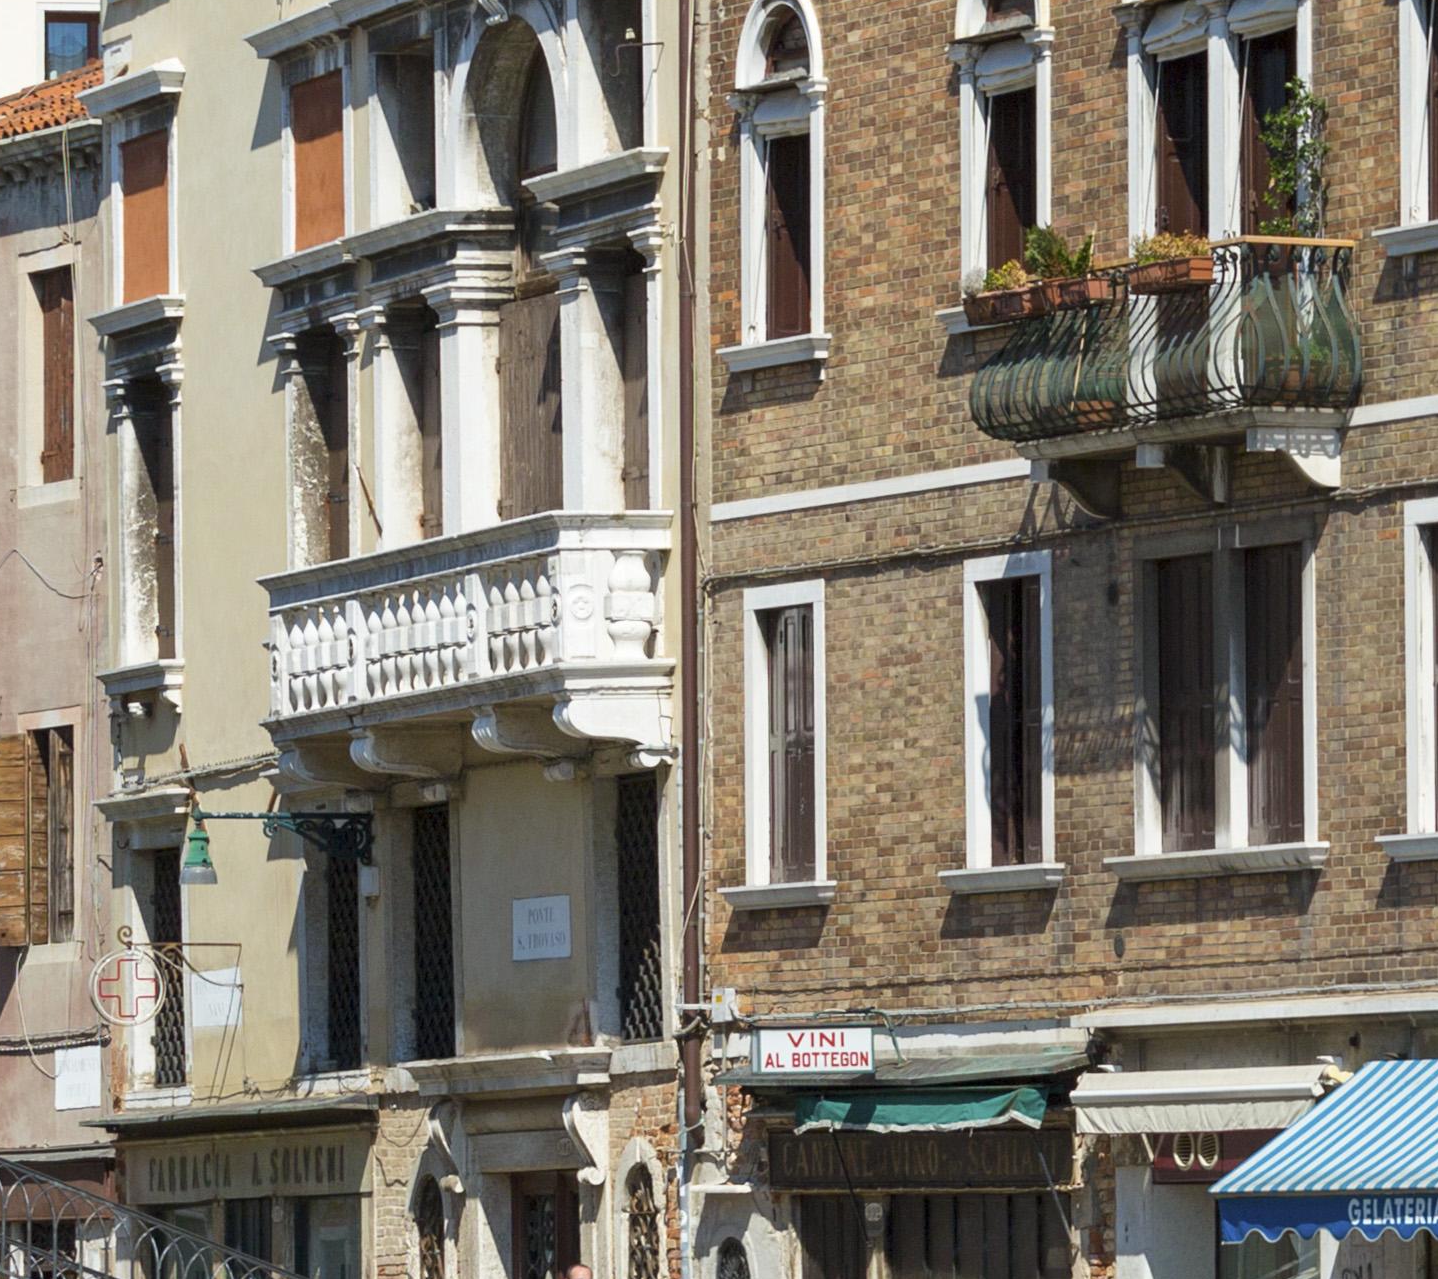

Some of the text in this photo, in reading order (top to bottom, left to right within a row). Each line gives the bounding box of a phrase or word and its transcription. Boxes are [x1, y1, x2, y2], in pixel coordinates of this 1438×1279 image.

[787, 1031, 845, 1048] VINI
[764, 1051, 869, 1068] AL BOTTEGON
